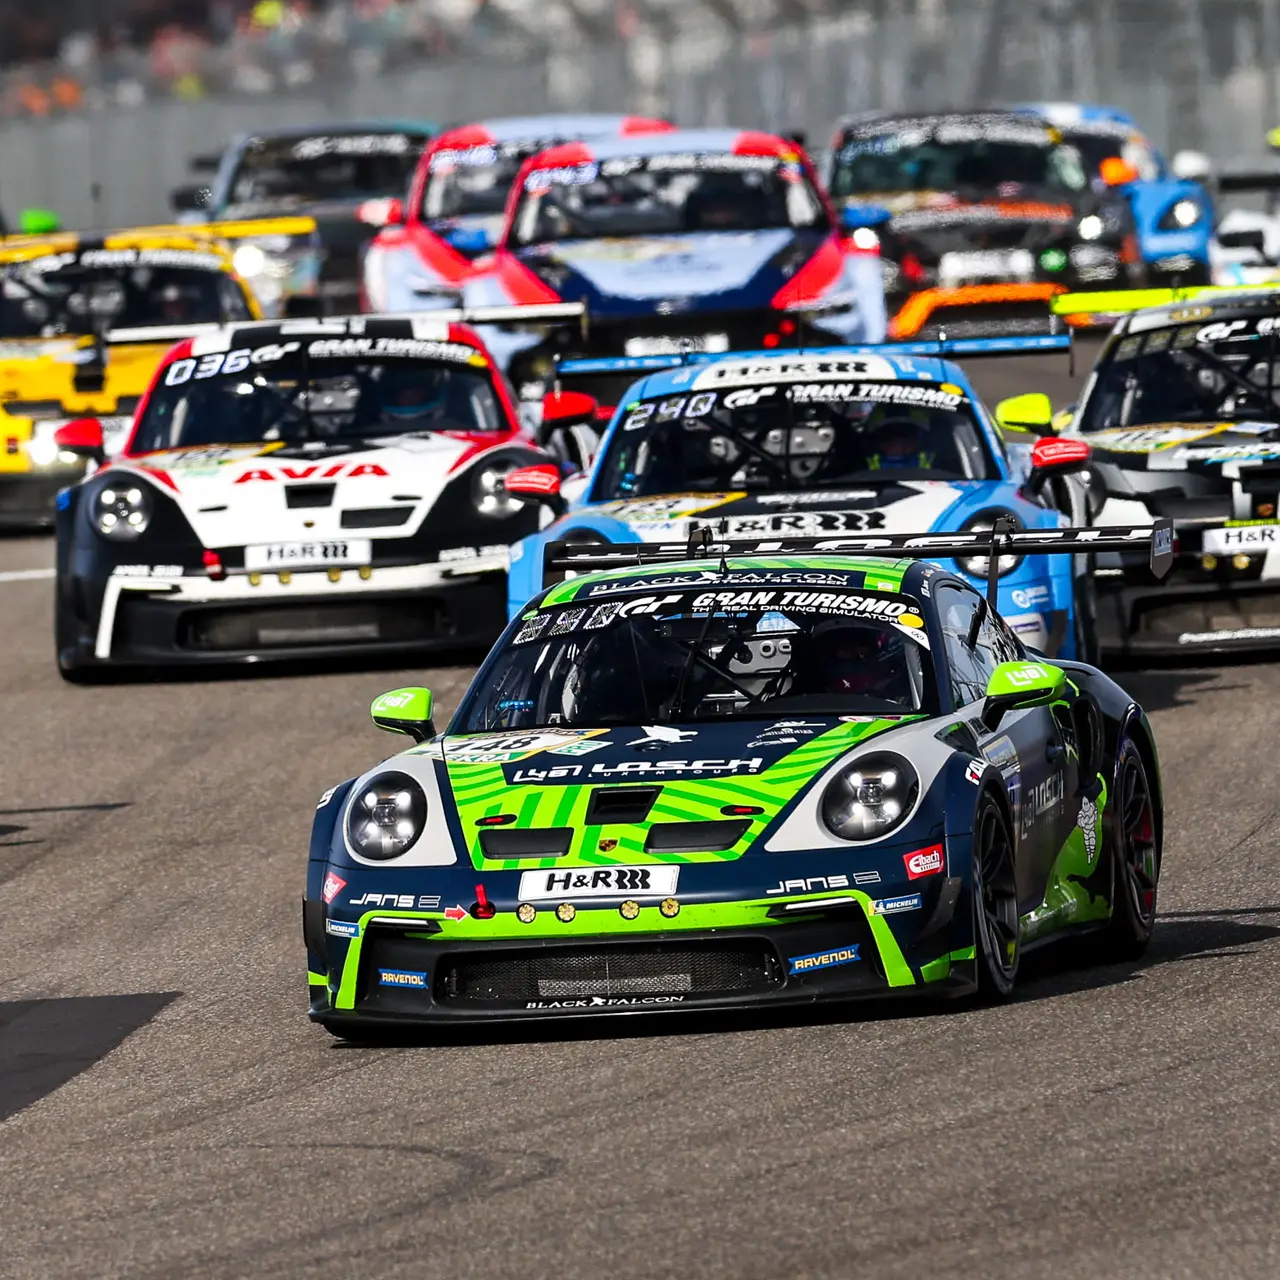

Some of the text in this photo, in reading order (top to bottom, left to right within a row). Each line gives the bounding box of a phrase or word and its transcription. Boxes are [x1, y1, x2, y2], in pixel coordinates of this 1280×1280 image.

[165, 349, 252, 386] 036
[860, 384, 959, 405] TURISMO
[234, 461, 390, 483] AVIA
[593, 572, 849, 592] BLACK FALCON
[692, 592, 786, 608] GRAN
[789, 593, 906, 614] TURISMO
[820, 608, 900, 622] SIMULATOR
[449, 736, 540, 752] 148
[590, 757, 762, 772] LOSCH
[767, 875, 848, 894] JANS
[350, 894, 415, 907] JANS
[886, 897, 918, 910] MICHELIN
[794, 950, 855, 970] RAVENOL
[382, 973, 423, 986] RAVENOL
[526, 995, 684, 1009] BLACK FALCON
